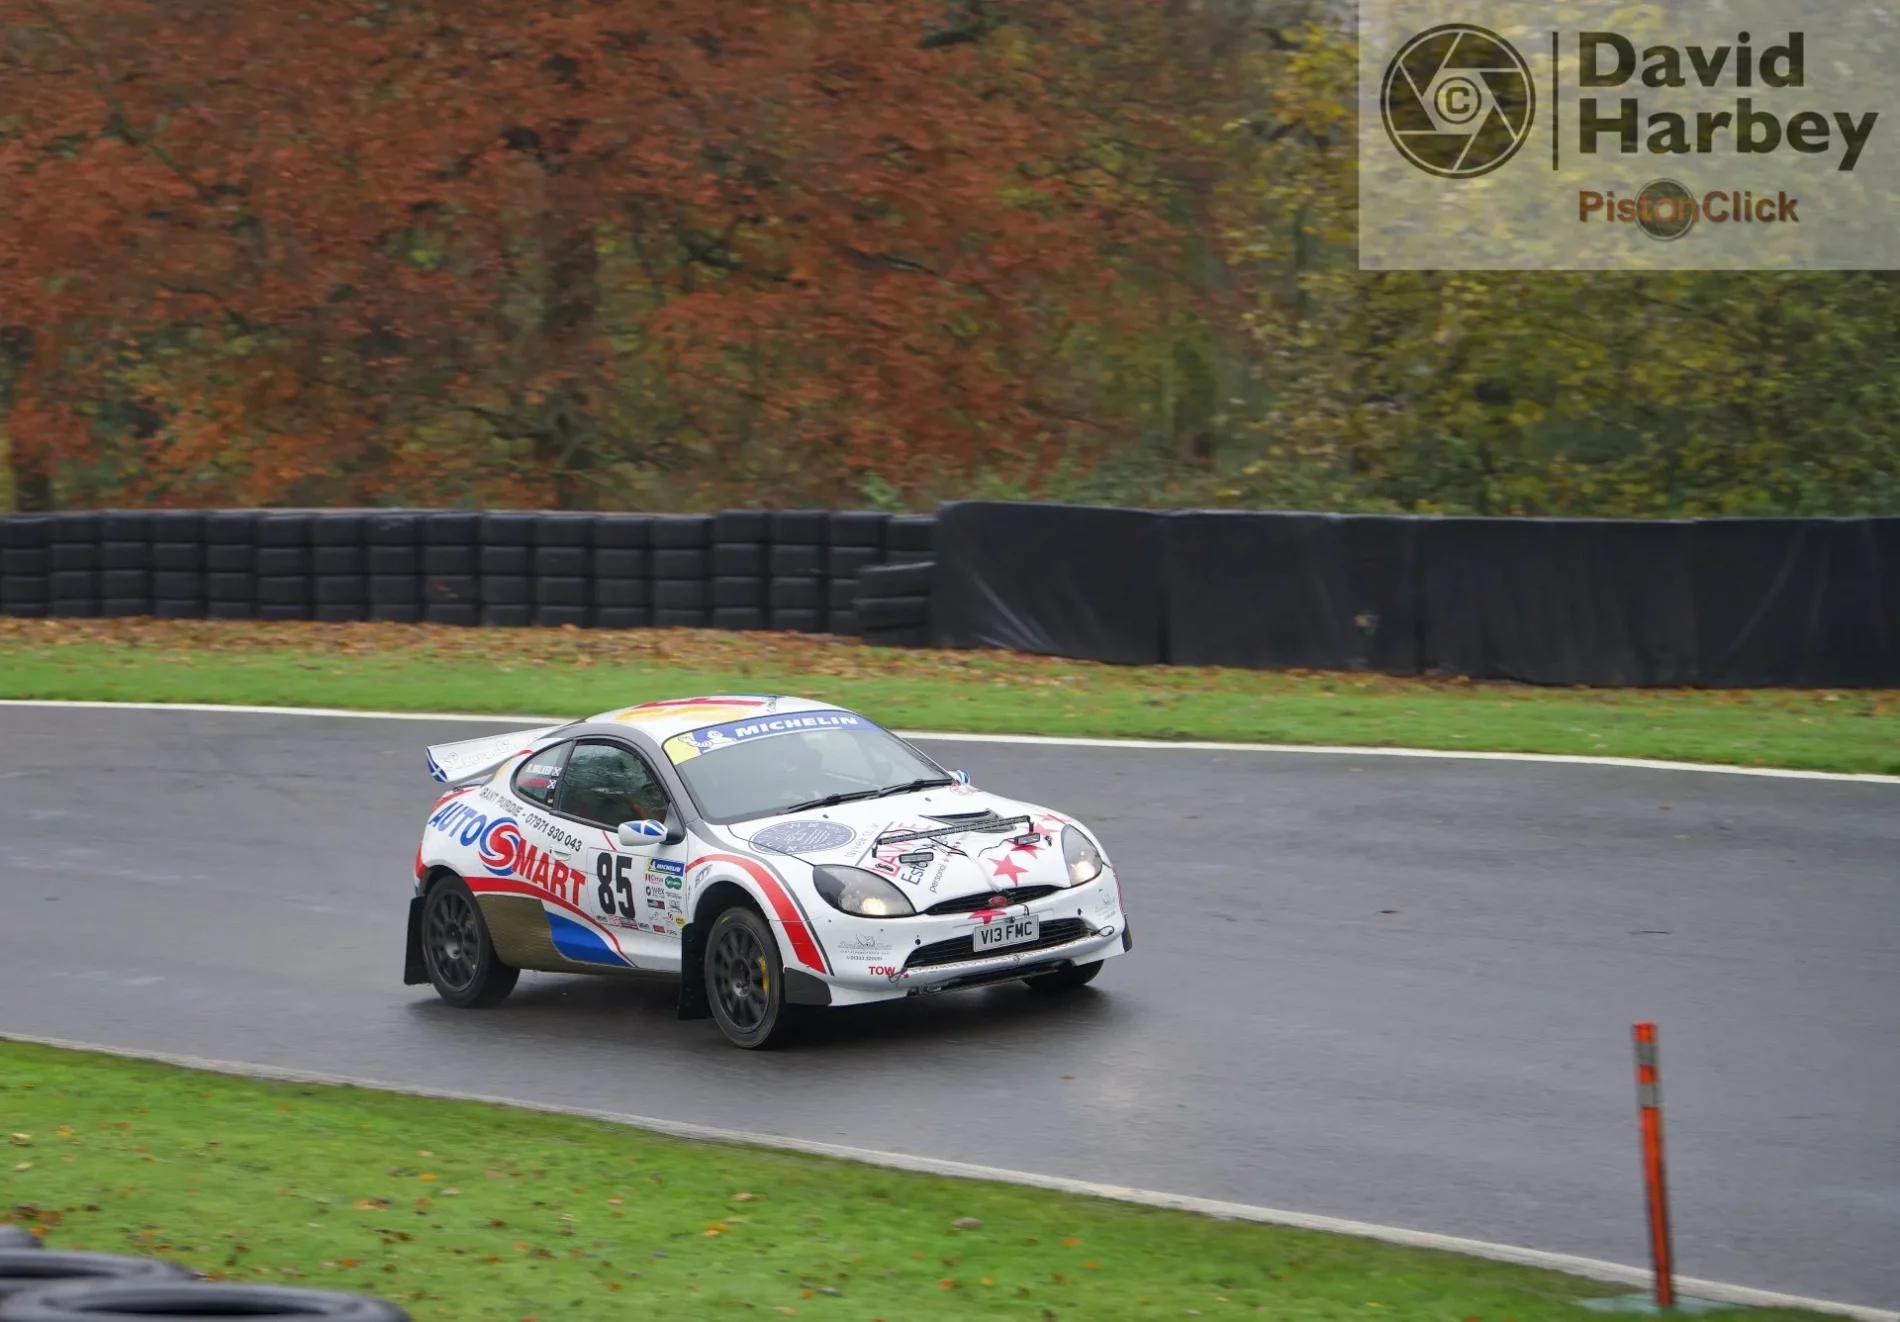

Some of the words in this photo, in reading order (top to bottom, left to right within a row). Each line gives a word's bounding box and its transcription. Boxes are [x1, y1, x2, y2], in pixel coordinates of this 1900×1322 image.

[734, 716, 860, 738] MICHELIN
[525, 813, 550, 833] 07971
[547, 827, 565, 843] 930
[564, 834, 583, 852] 043
[656, 863, 681, 873] MICHELIN
[597, 851, 636, 919] 85
[980, 925, 1001, 945] V13
[1006, 920, 1033, 940] FMC
[868, 965, 895, 976] TOW
